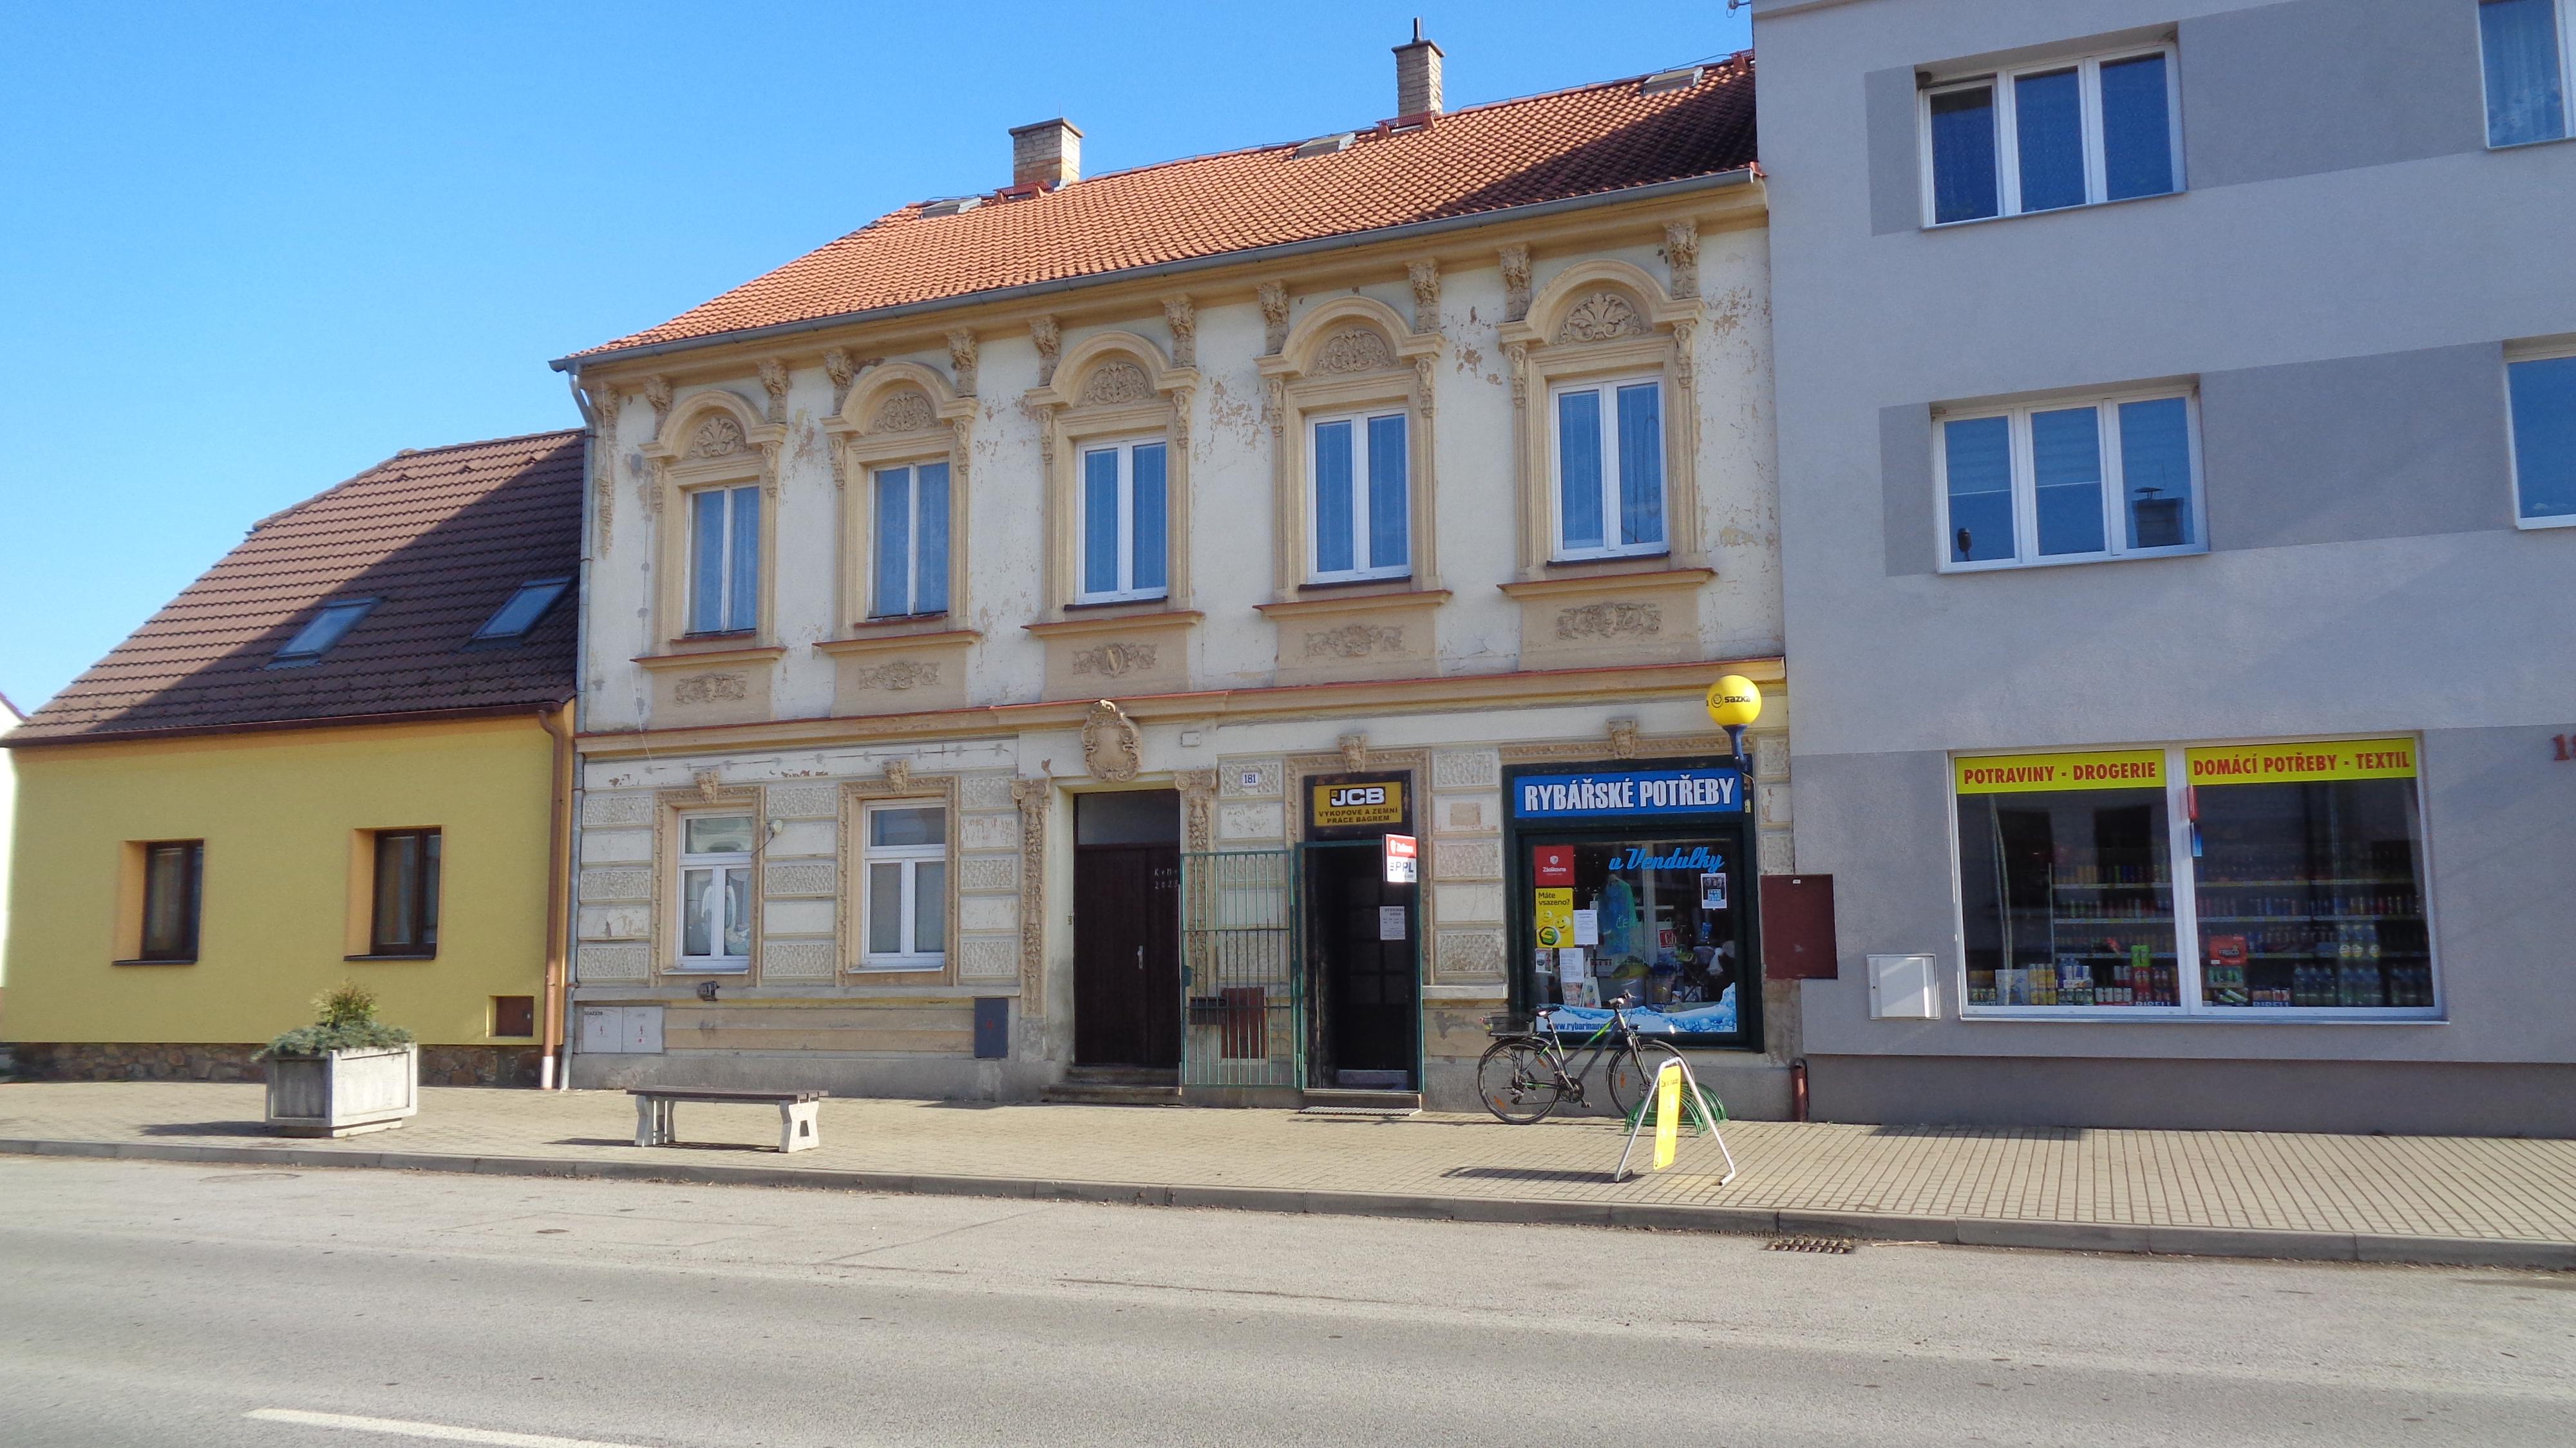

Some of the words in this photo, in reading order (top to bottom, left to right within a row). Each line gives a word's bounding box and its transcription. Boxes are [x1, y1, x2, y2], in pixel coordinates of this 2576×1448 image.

[2553, 734, 2576, 761] 1
[1964, 766, 2054, 784] POTRAVINY
[2073, 762, 2156, 780] DROGERIE
[2193, 754, 2257, 776] DOMÁCÍ
[2264, 752, 2337, 773] POTŘEBY
[2356, 752, 2410, 769] TEXTIL
[1244, 774, 1256, 783] 181
[1331, 788, 1385, 806] JCB
[1525, 778, 1634, 811] RYBÁŘSKÉ
[1640, 774, 1735, 806] POTŘEBY
[1396, 862, 1414, 873] PPL
[1609, 856, 1624, 870] u
[1625, 847, 1725, 874] Vendulky
